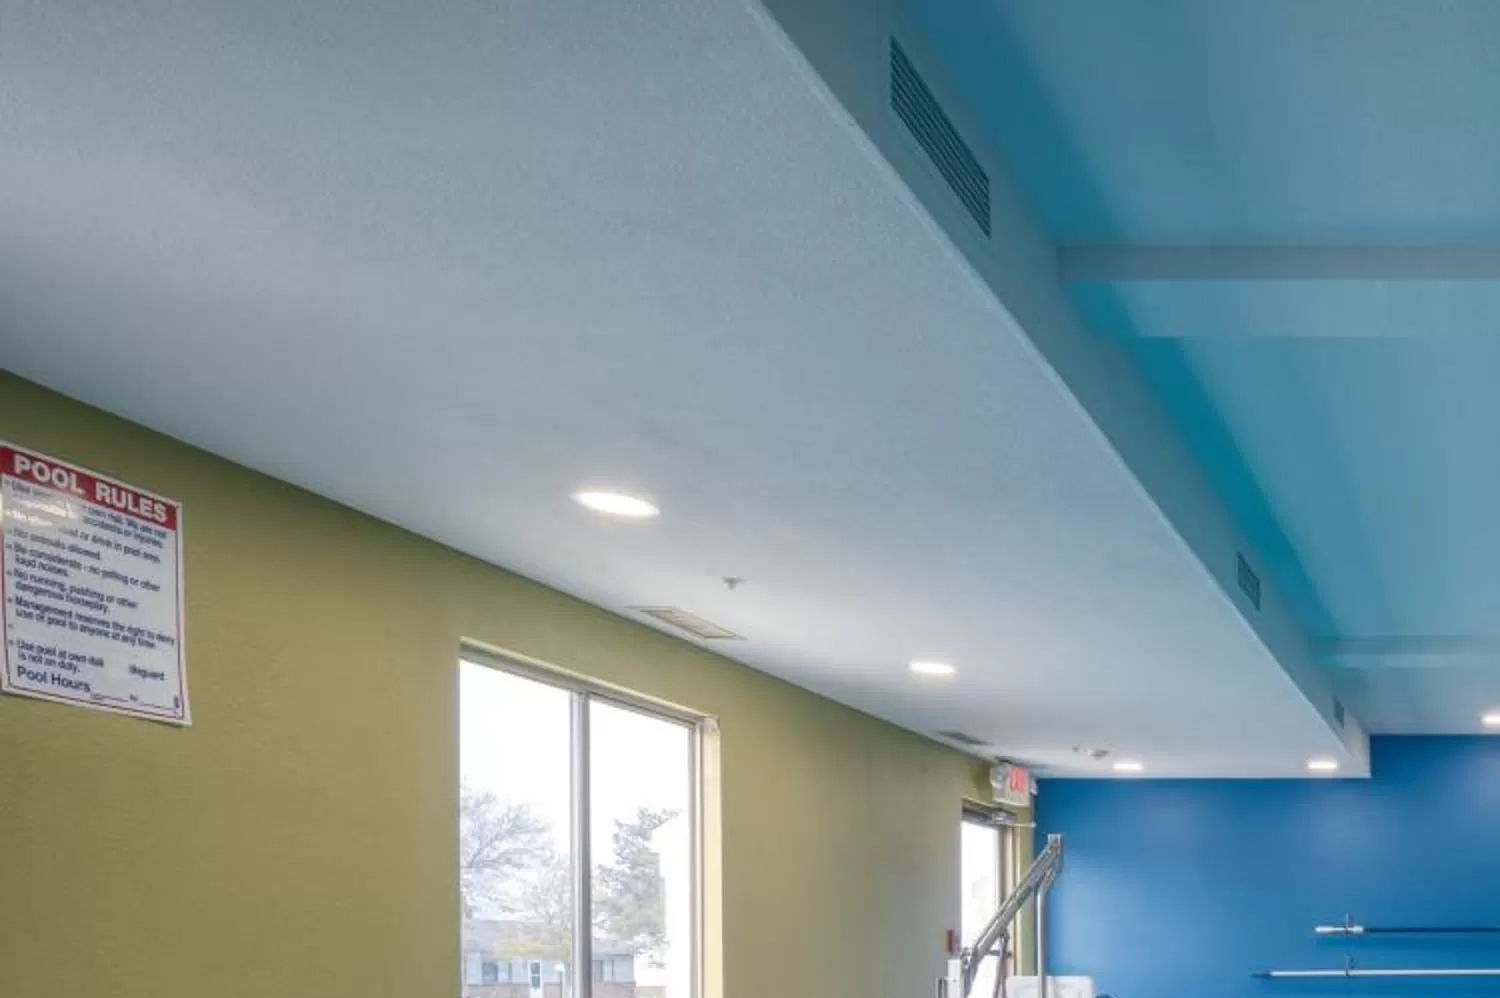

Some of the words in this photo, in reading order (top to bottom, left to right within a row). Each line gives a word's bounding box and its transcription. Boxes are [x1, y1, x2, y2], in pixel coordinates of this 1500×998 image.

[13, 454, 84, 494] POOL
[95, 481, 167, 523] RULES
[17, 665, 47, 681] Pool
[51, 673, 90, 690] Hours
